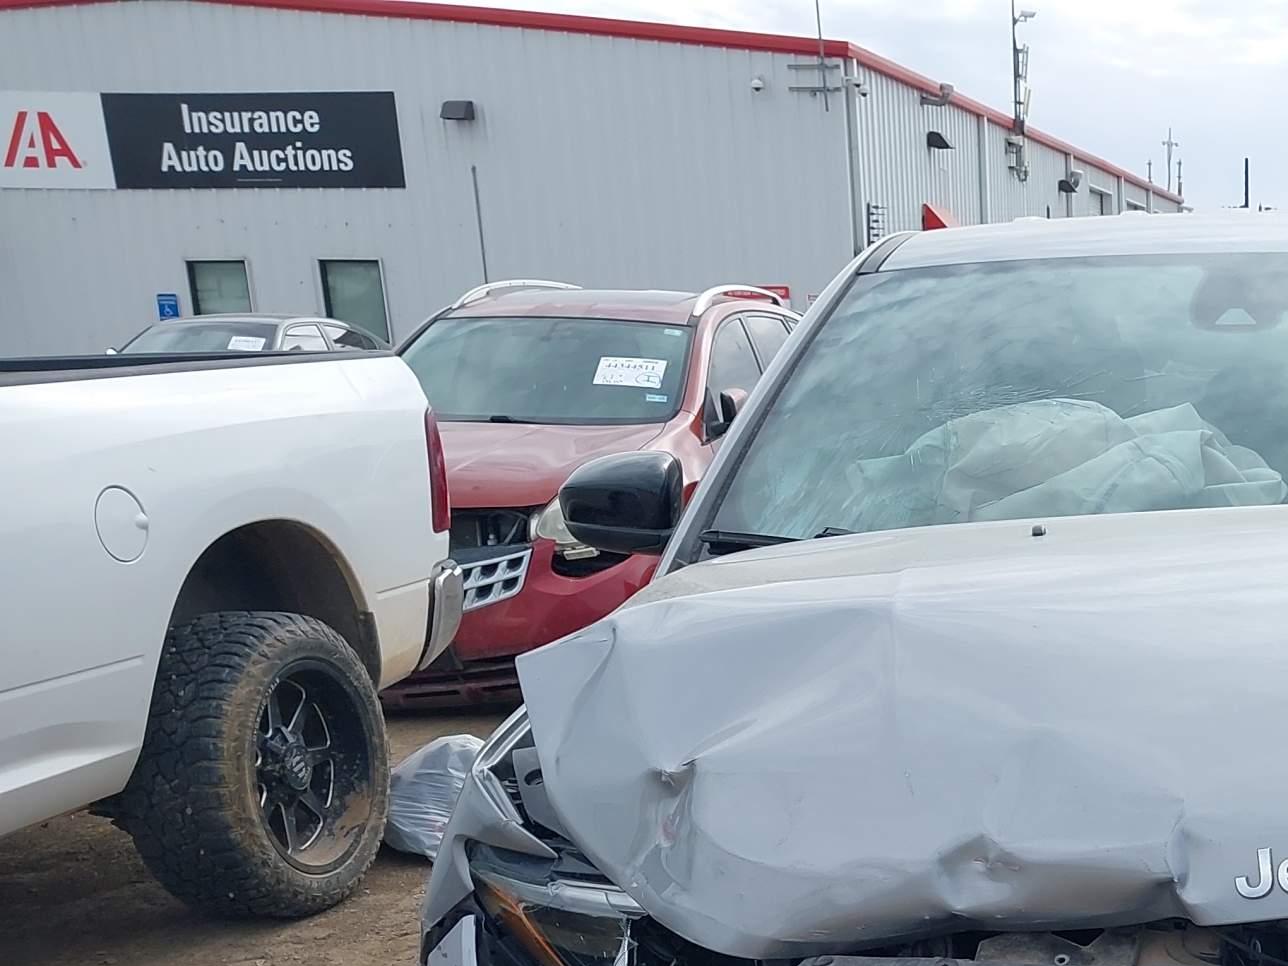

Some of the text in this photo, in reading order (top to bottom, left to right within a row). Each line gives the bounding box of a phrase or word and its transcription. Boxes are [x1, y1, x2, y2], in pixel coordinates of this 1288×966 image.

[180, 103, 320, 133] Insurance
[161, 141, 354, 172] Auto Auctions
